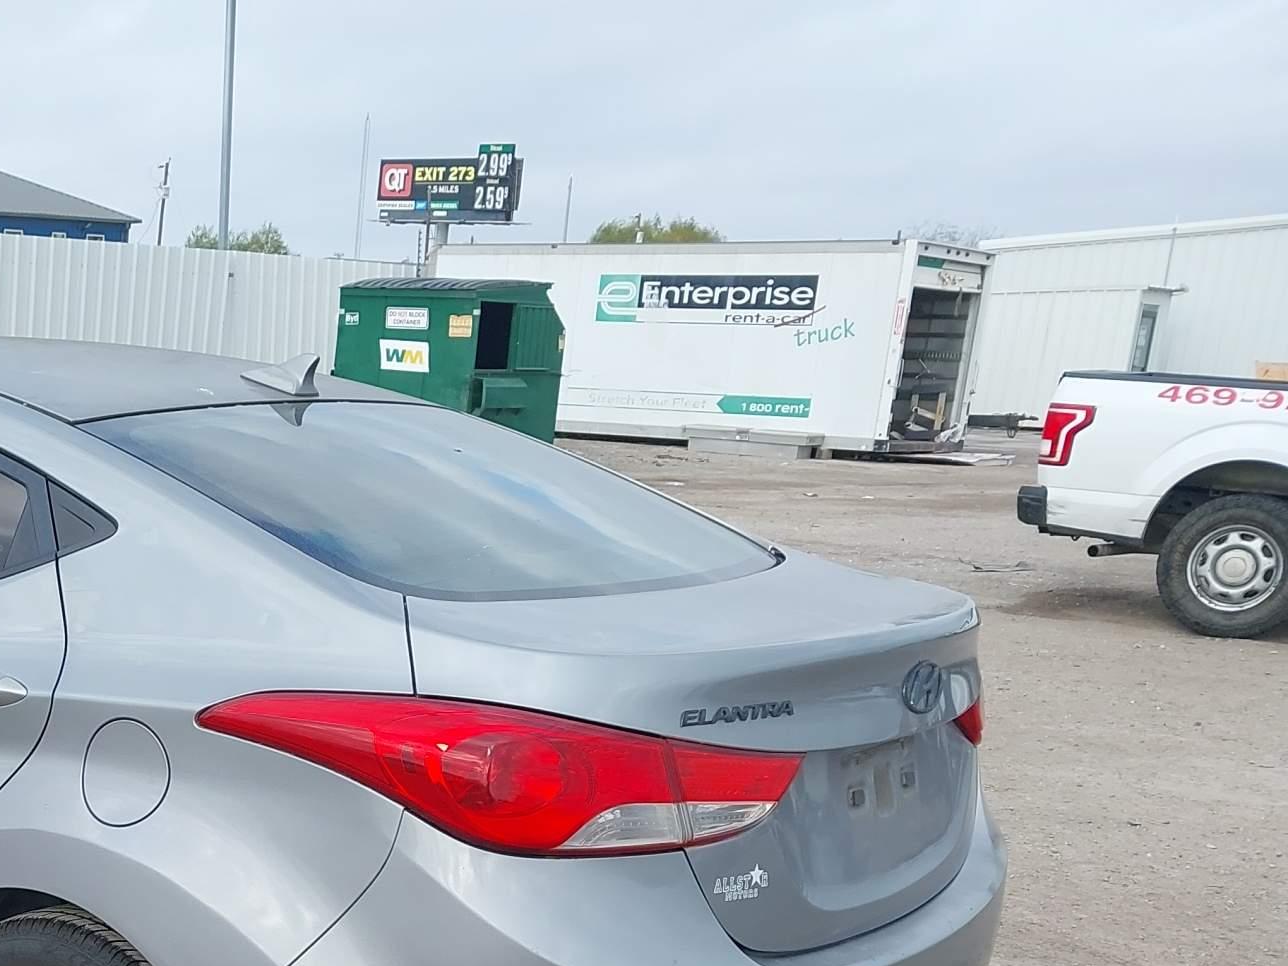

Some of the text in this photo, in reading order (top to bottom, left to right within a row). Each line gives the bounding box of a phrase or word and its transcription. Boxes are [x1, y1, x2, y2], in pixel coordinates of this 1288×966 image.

[384, 168, 408, 192] QT
[415, 166, 475, 181] EXIT 273
[439, 185, 459, 193] MILES
[642, 279, 813, 310] Enterprise
[793, 318, 856, 347] truck
[385, 347, 423, 364] WM
[741, 402, 810, 414] 1 800 rent-
[1158, 385, 1288, 410] 469-9
[680, 701, 794, 727] ELANTRA
